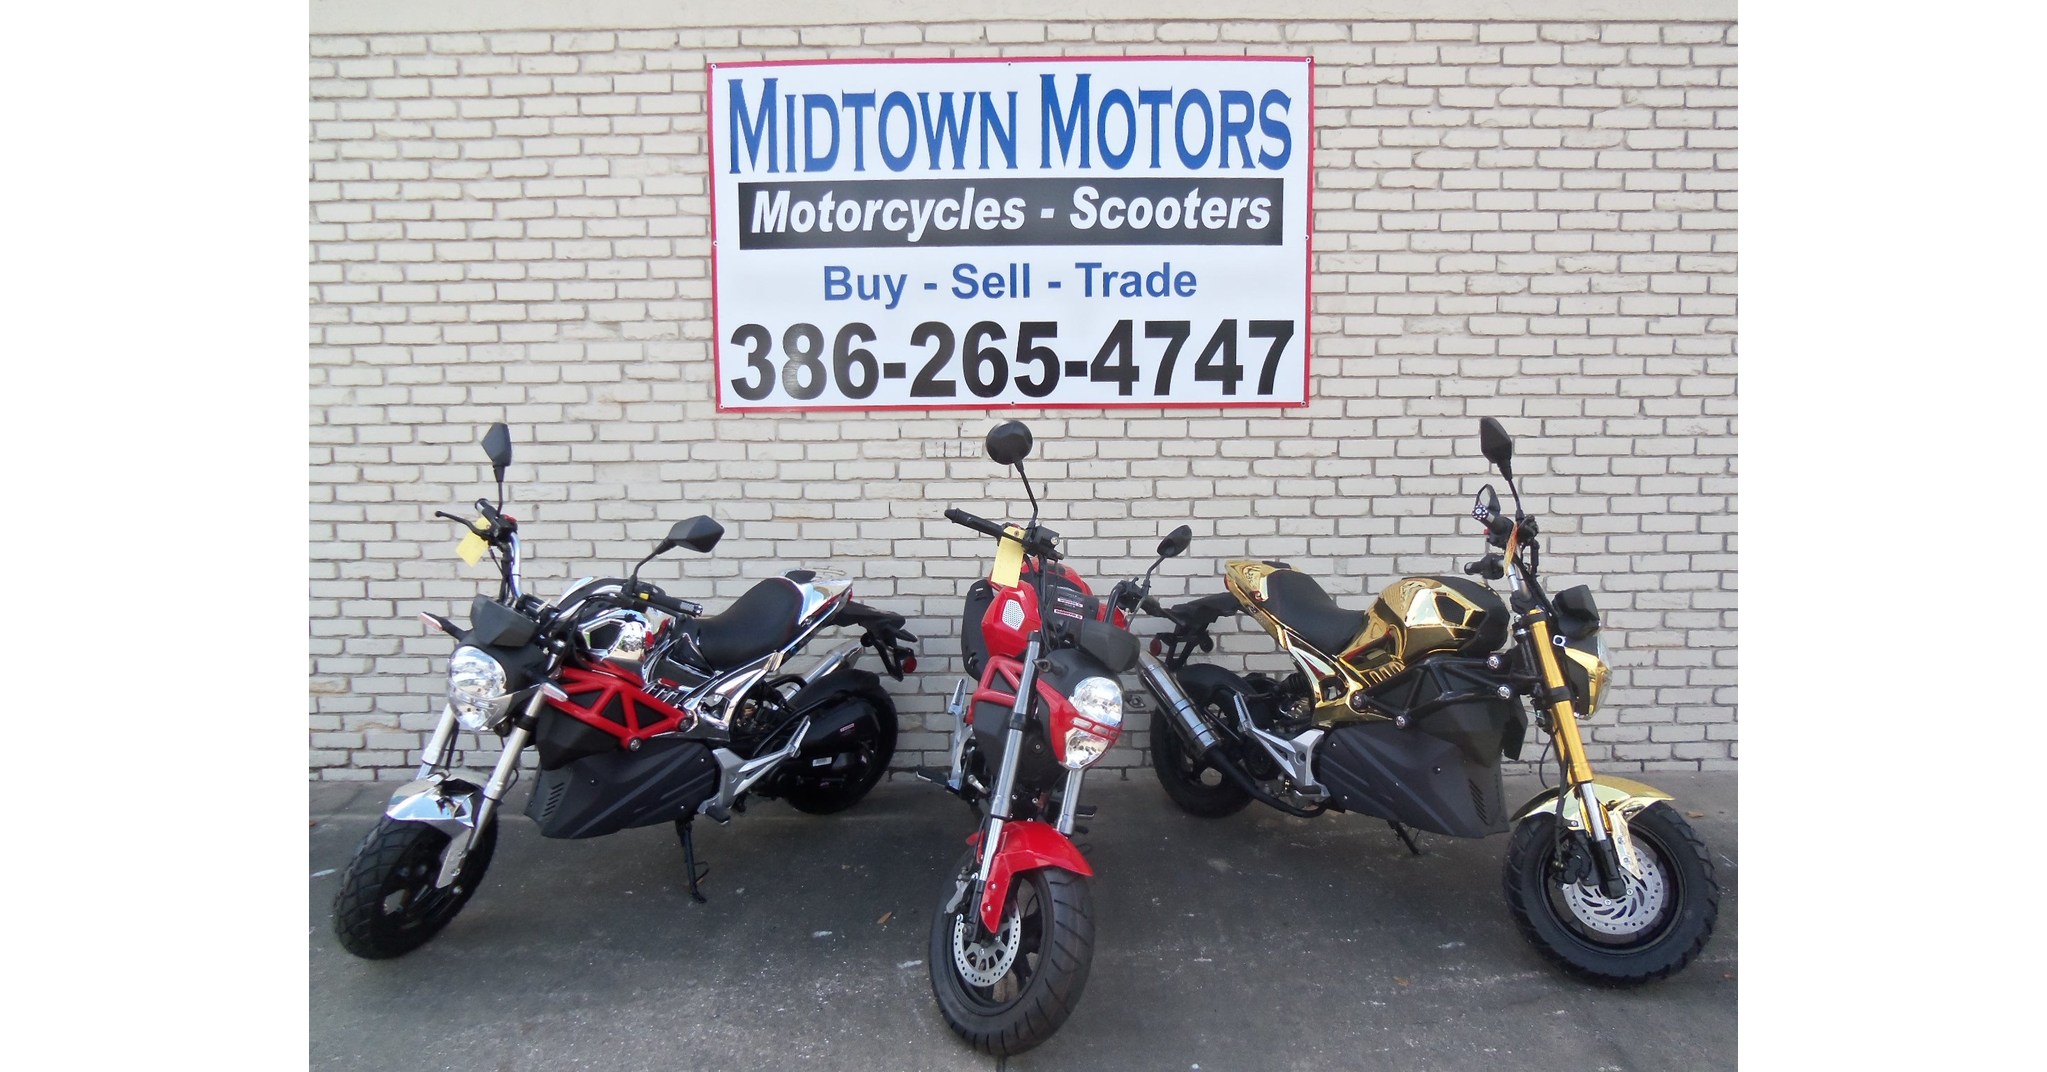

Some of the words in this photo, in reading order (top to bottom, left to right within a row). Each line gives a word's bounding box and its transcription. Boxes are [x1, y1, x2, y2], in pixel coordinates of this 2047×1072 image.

[728, 77, 1018, 174] MIDTOWN
[1039, 73, 1292, 169] MOTORS
[751, 187, 1026, 242] Motorcycles
[1069, 186, 1271, 231] Scooters
[823, 264, 908, 310] Buy
[950, 262, 1031, 299] Sell
[1074, 261, 1198, 298] Trade
[730, 318, 1295, 400] 386-265-4747
